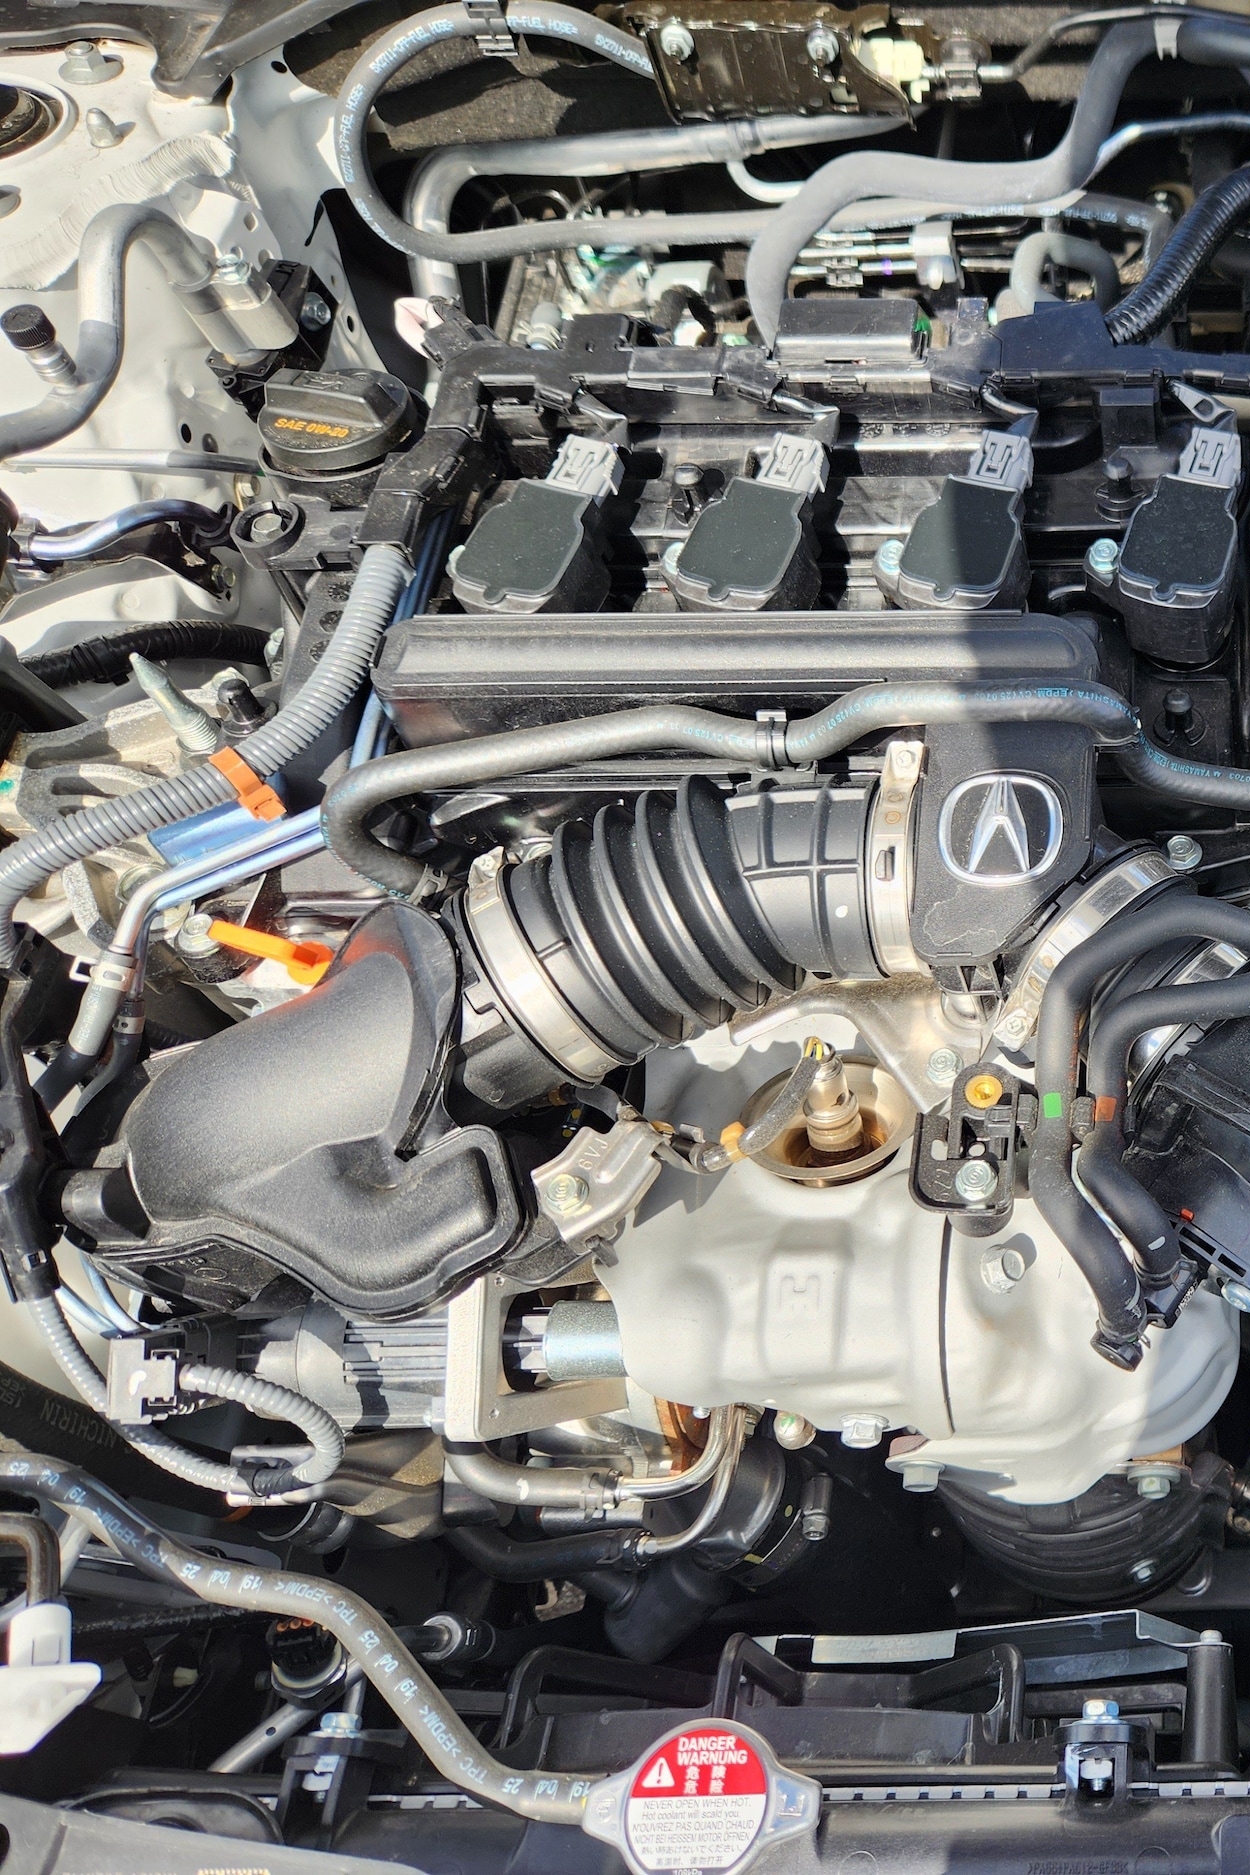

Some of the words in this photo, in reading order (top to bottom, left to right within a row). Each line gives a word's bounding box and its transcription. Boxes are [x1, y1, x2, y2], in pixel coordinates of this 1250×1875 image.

[274, 418, 307, 431] SAE
[305, 423, 349, 438] 0W-20
[1078, 690, 1132, 719] YAMASHITA
[1170, 762, 1211, 778] YAMASHITA
[578, 1137, 609, 1171] 6VJ
[39, 1399, 117, 1448] NICHIRIN
[141, 1545, 168, 1569] TPC
[332, 1601, 358, 1626] TPC
[678, 1736, 737, 1751] DANGER
[677, 1749, 748, 1765] WARNUNG
[459, 1755, 488, 1785] TPC
[501, 1778, 524, 1795] 25
[643, 1800, 673, 1809] NEVER
[675, 1799, 700, 1809] OPEN
[702, 1798, 729, 1808] WHEN
[730, 1797, 751, 1807] HOT.
[642, 1812, 656, 1820] Hot
[657, 1811, 685, 1820] coolant
[687, 1810, 699, 1818] will
[701, 1810, 722, 1818] scald
[632, 1822, 674, 1832] N'OUVREZ
[675, 1822, 692, 1831] PAS
[694, 1821, 723, 1831] QUAND
[635, 1835, 654, 1844] NICHT
[655, 1834, 666, 1843] BEI
[698, 1833, 722, 1842] MOTOR
